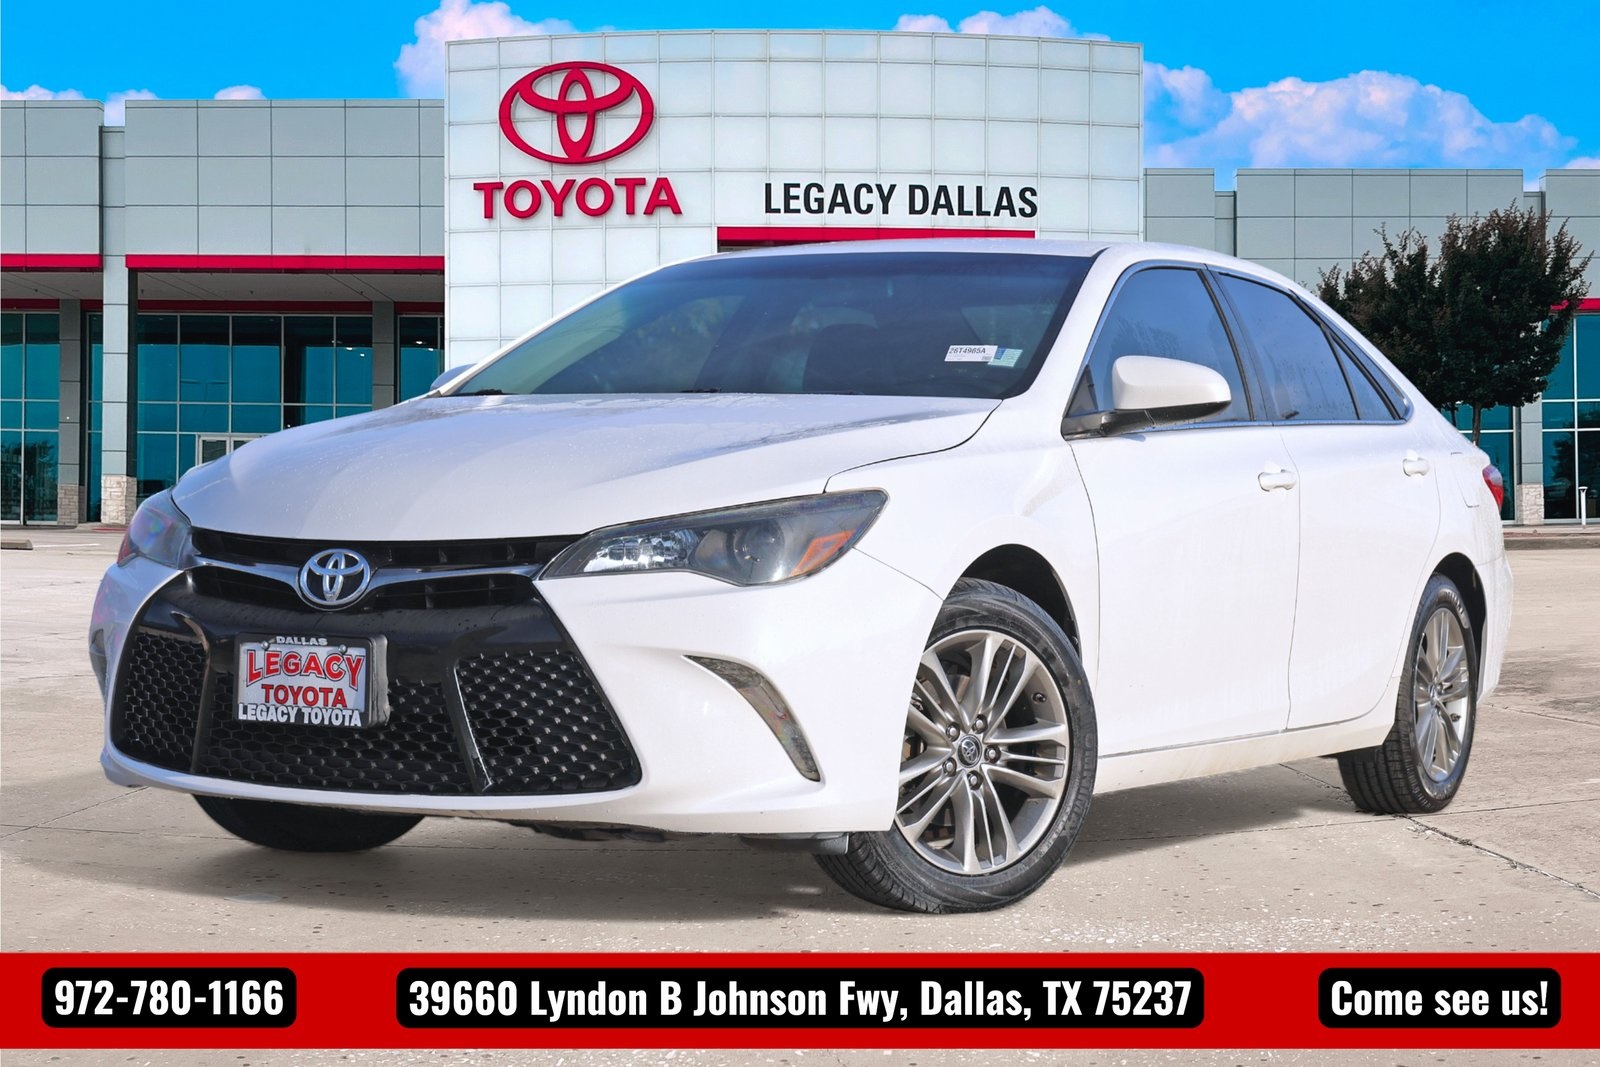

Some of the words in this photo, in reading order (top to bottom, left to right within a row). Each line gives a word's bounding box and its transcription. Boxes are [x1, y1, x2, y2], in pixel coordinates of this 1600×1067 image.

[474, 177, 682, 219] TOYOTA
[764, 182, 897, 215] LEGACY
[908, 184, 1038, 218] DALLAS
[276, 636, 328, 646] DALLAS
[246, 649, 365, 691] LEGACY
[261, 684, 348, 708] TOYOTA
[238, 703, 298, 723] LEGACY
[302, 706, 361, 727] TOYOTA
